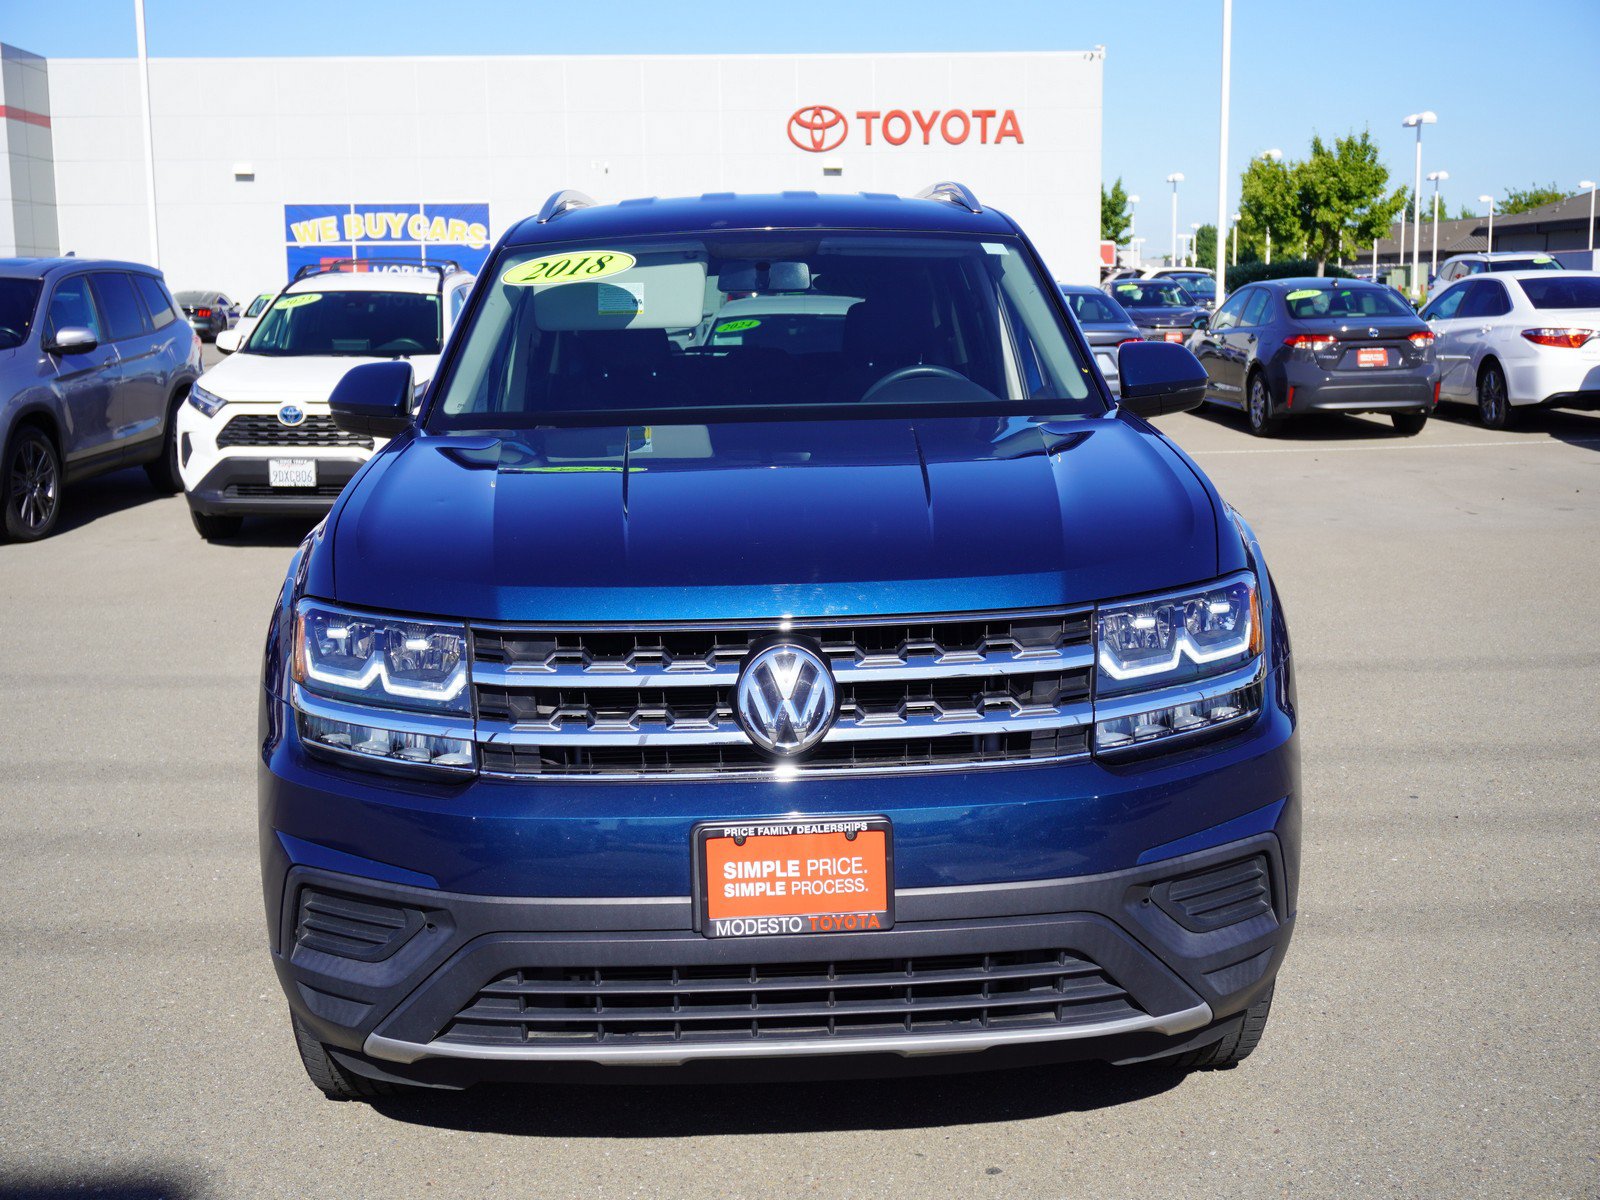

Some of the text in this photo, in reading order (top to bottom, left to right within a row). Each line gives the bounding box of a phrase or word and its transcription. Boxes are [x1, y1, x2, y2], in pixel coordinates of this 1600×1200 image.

[856, 109, 1024, 146] TOYOTA
[290, 212, 487, 249] WE BUY CARS
[520, 254, 614, 281] 2018
[272, 470, 313, 483] 9DXC806
[724, 822, 868, 837] PRICE FAMILY DEALERSHIPS
[723, 857, 868, 880] SIMPLE PRICE.
[723, 878, 869, 898] SIMPLE PROCESS.
[716, 914, 881, 936] MODESTO TOYOTA
